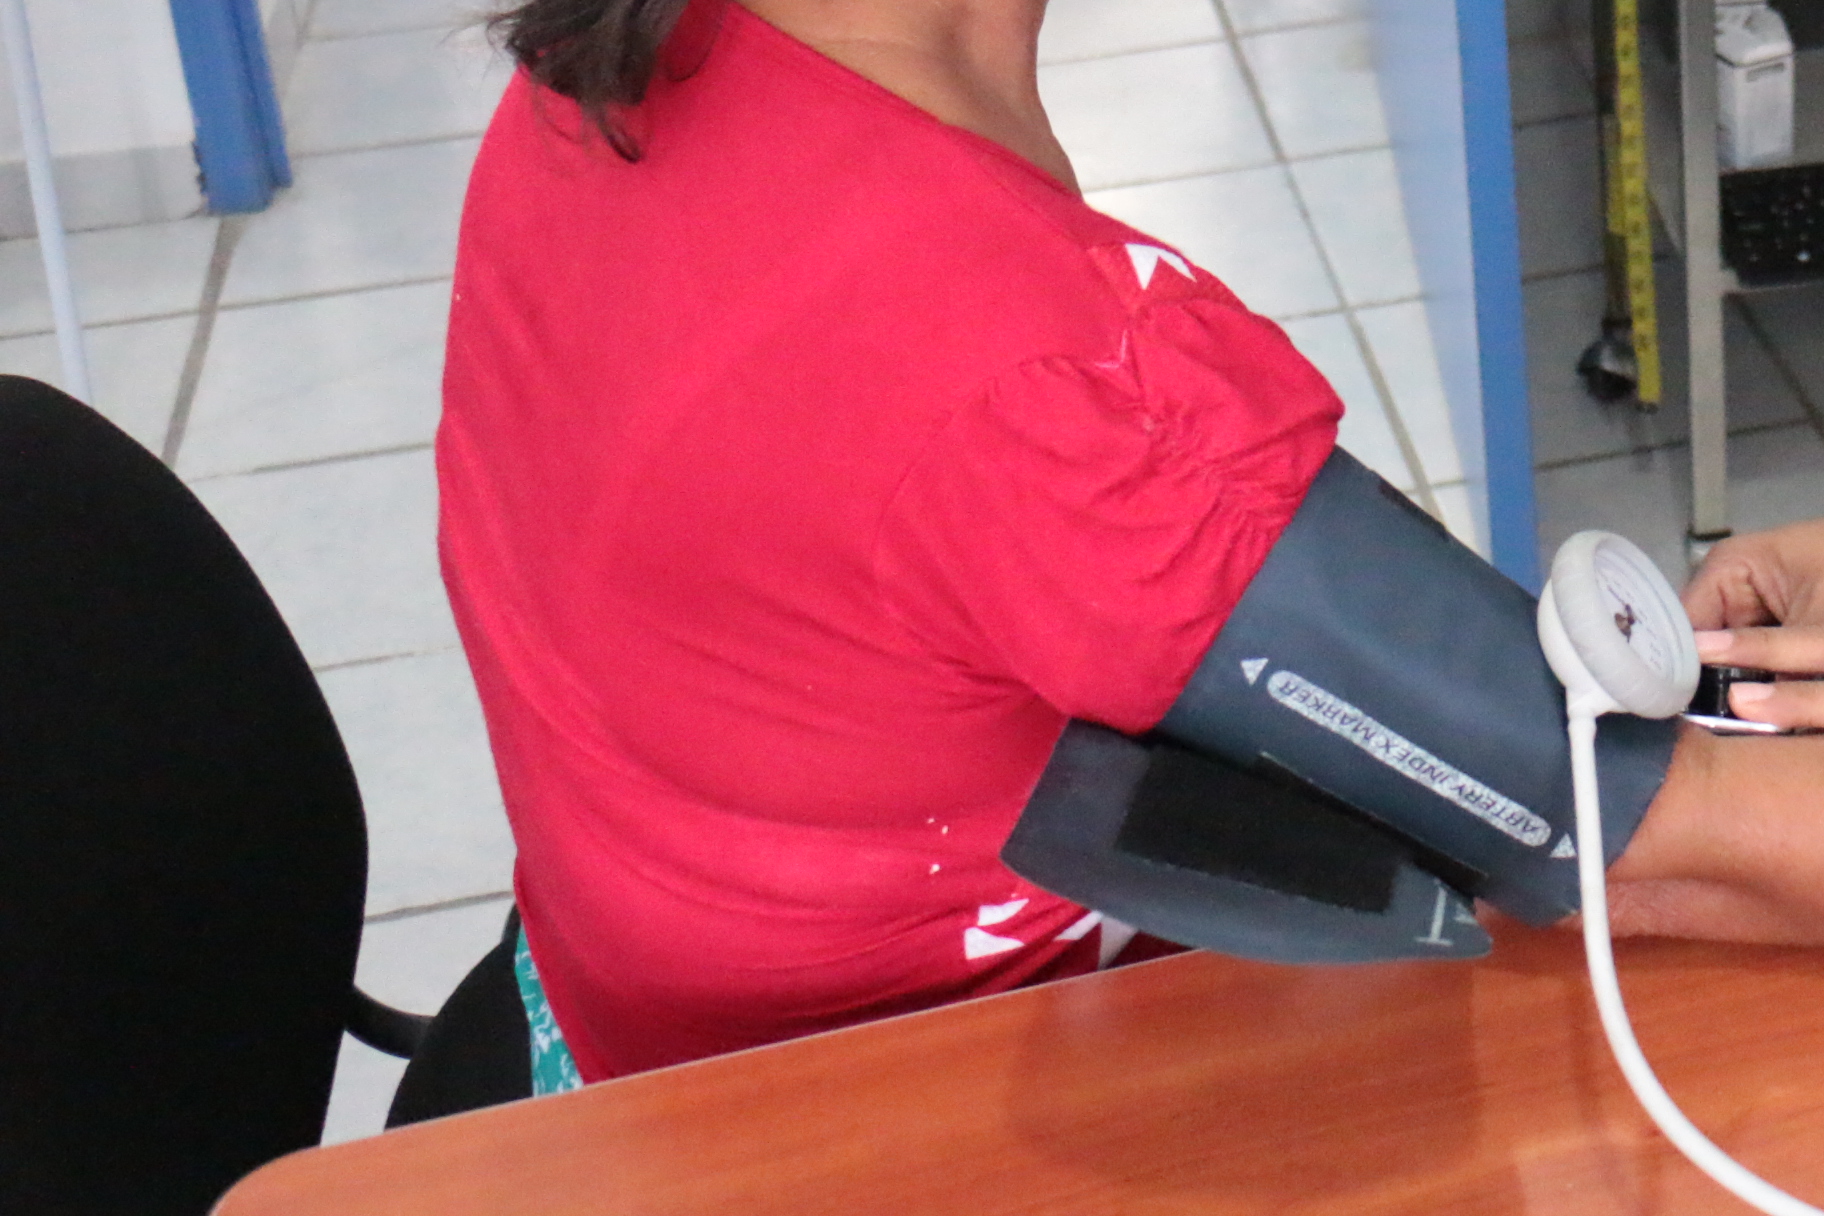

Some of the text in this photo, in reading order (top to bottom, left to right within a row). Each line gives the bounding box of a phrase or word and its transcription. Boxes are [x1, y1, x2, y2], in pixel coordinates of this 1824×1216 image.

[1280, 679, 1540, 836] ARTERY INDEX MARKER
